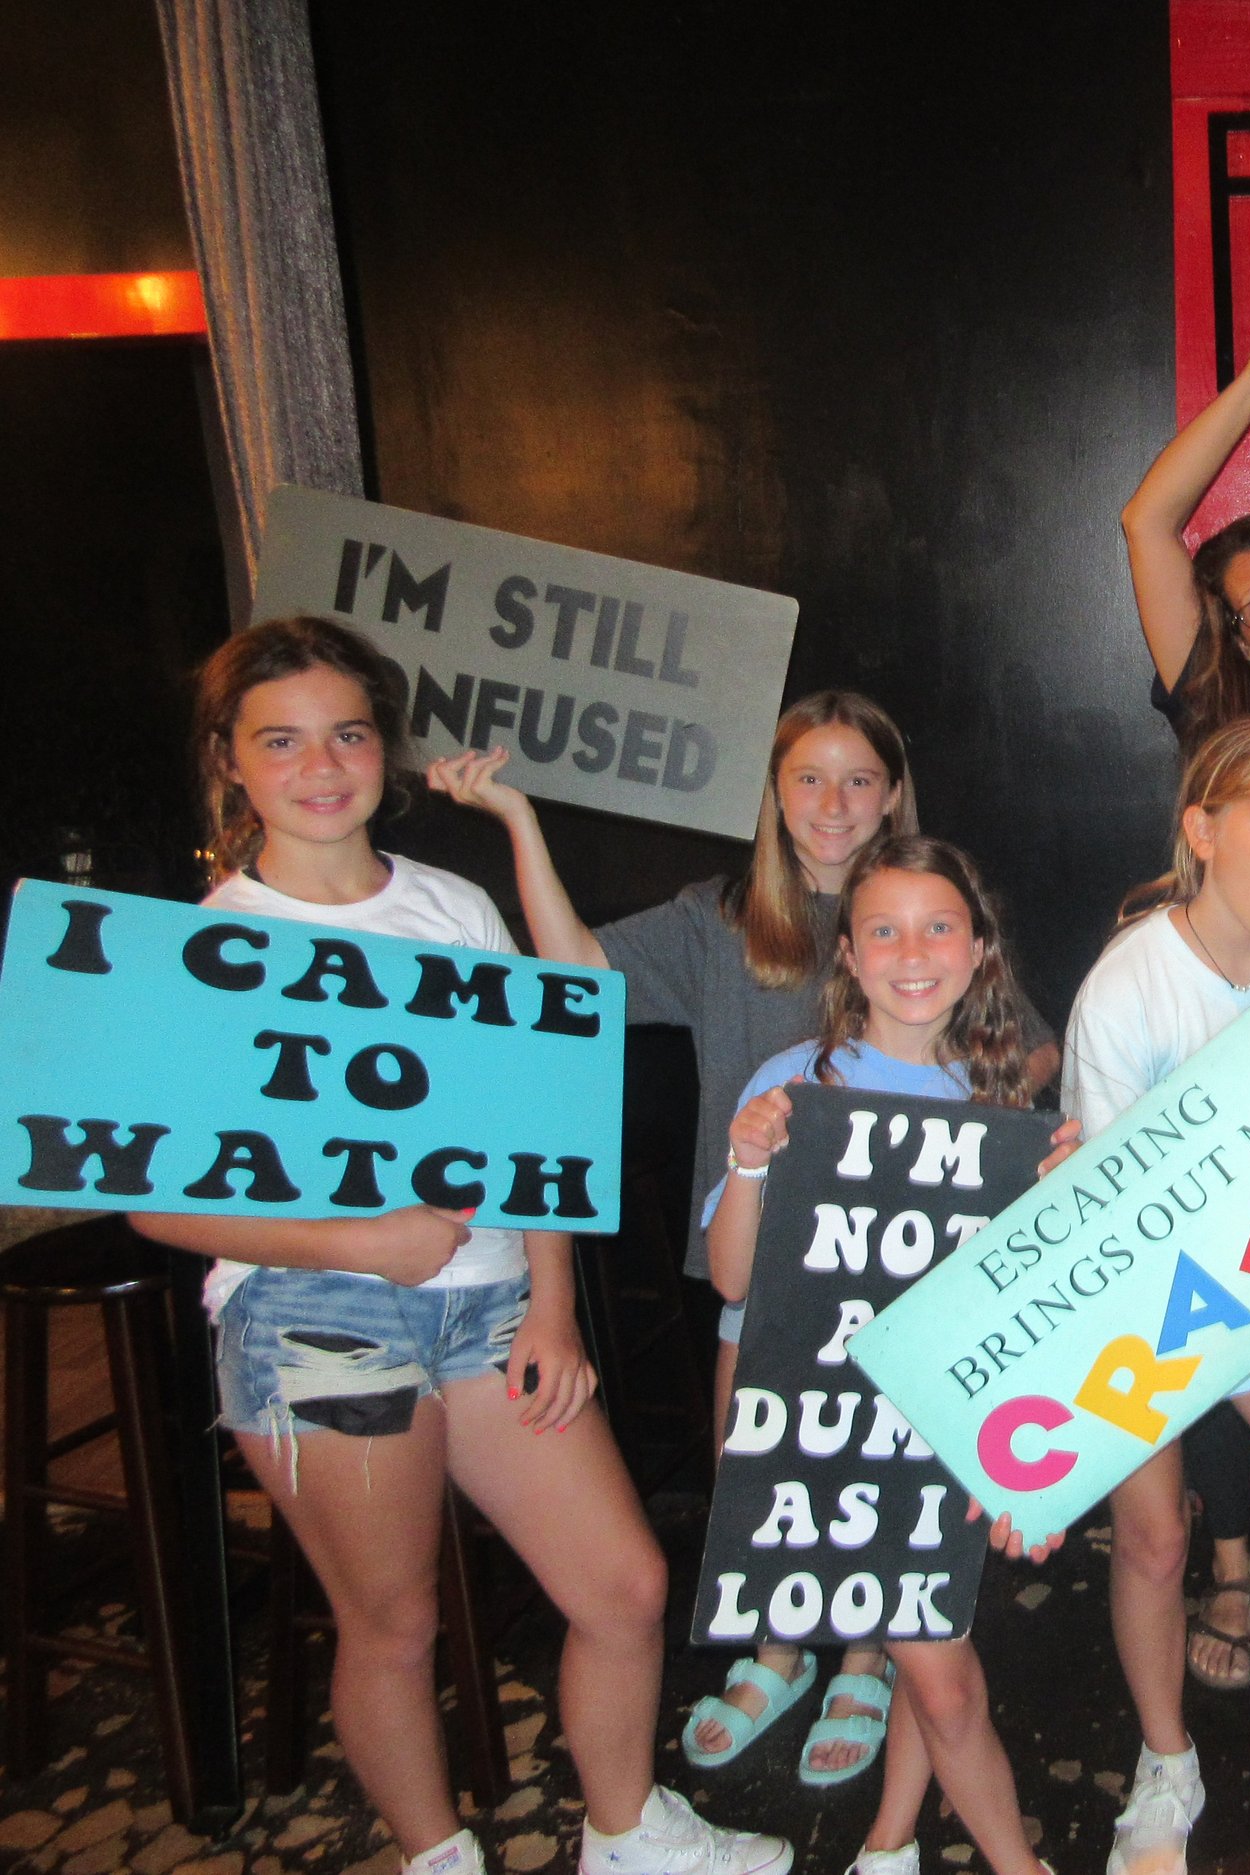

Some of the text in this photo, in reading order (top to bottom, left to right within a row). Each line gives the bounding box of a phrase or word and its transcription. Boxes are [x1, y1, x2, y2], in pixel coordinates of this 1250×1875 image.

[334, 538, 700, 688] I'M STILL
[378, 655, 718, 793] NFUSED
[46, 900, 601, 1038] I CAME
[253, 1029, 430, 1110] TO
[17, 1114, 598, 1218] WATCH
[836, 1110, 988, 1189] I'M
[975, 1083, 1219, 1295] ESCAPING
[945, 1234, 1134, 1399] BRINGS
[1136, 1144, 1237, 1241] OUT
[723, 1387, 935, 1459] DUM
[751, 1480, 948, 1549] AS I
[707, 1570, 954, 1640] LOOK
